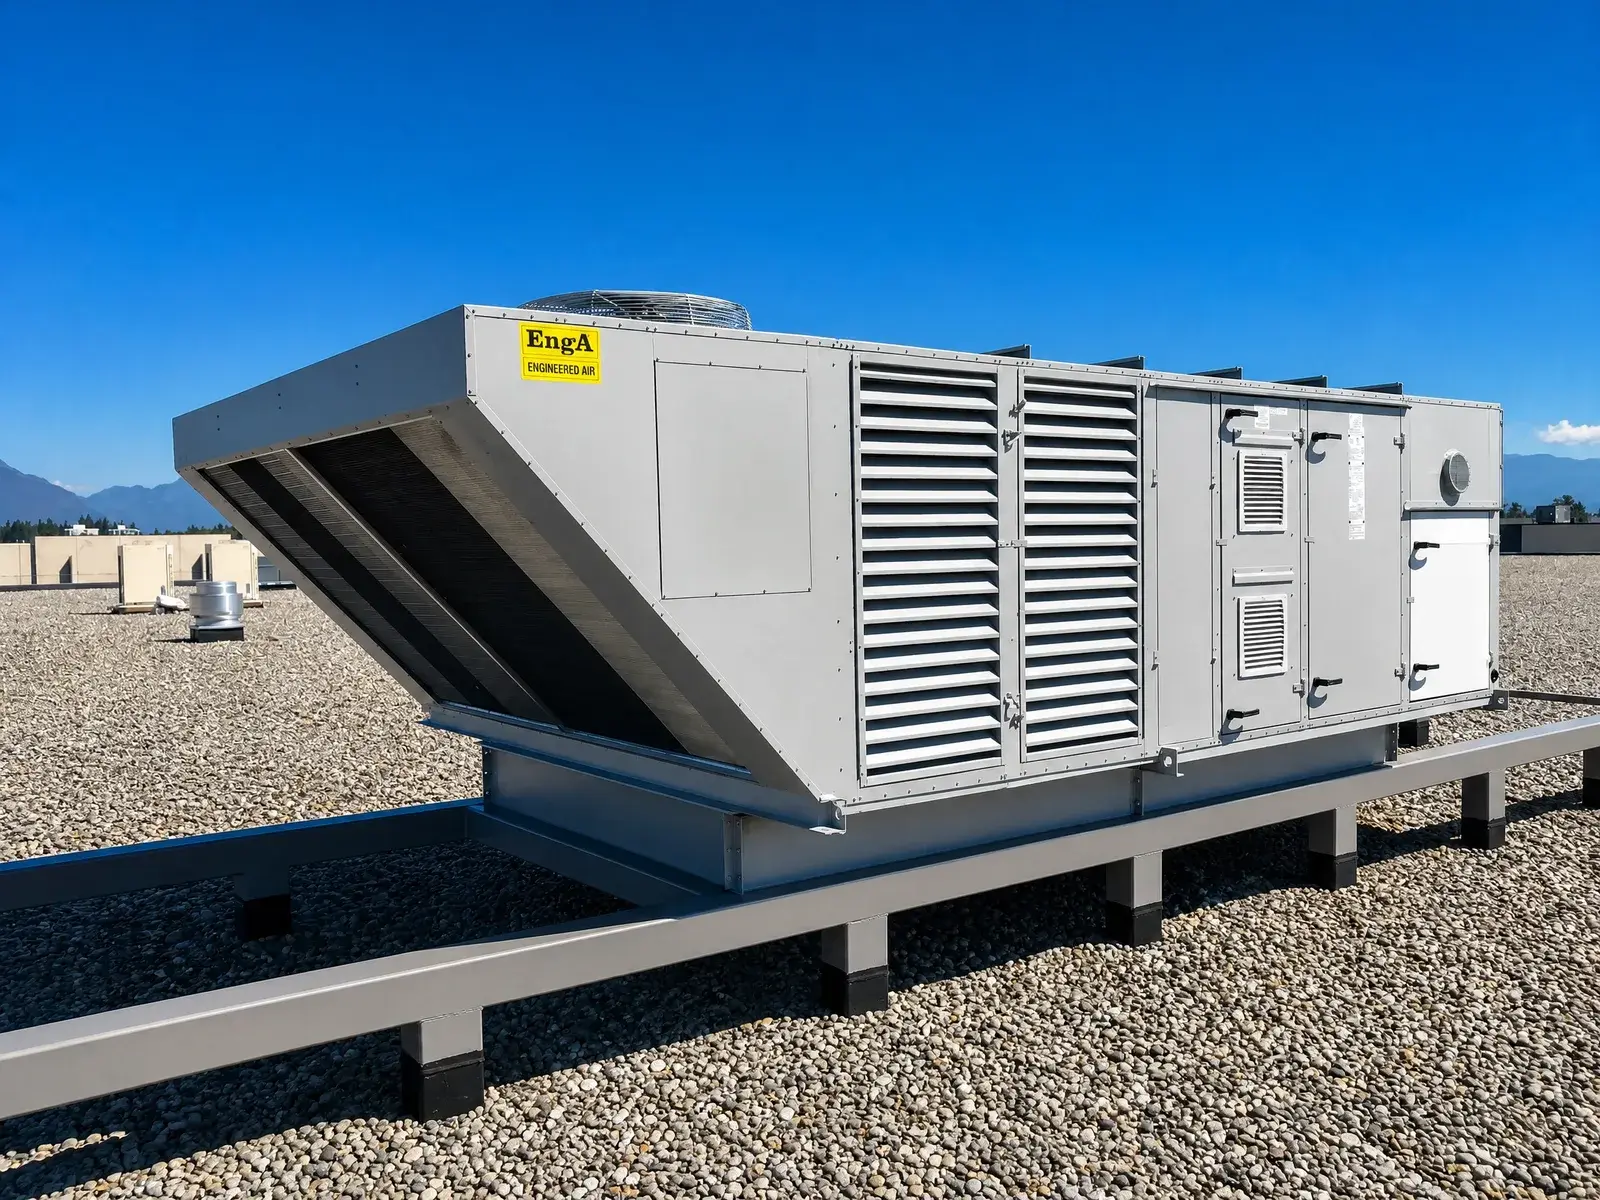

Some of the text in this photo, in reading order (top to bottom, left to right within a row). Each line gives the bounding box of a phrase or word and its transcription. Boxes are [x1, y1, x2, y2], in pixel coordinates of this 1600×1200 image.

[526, 329, 594, 356] EngA
[528, 362, 595, 376] ENGINEERED AIR
